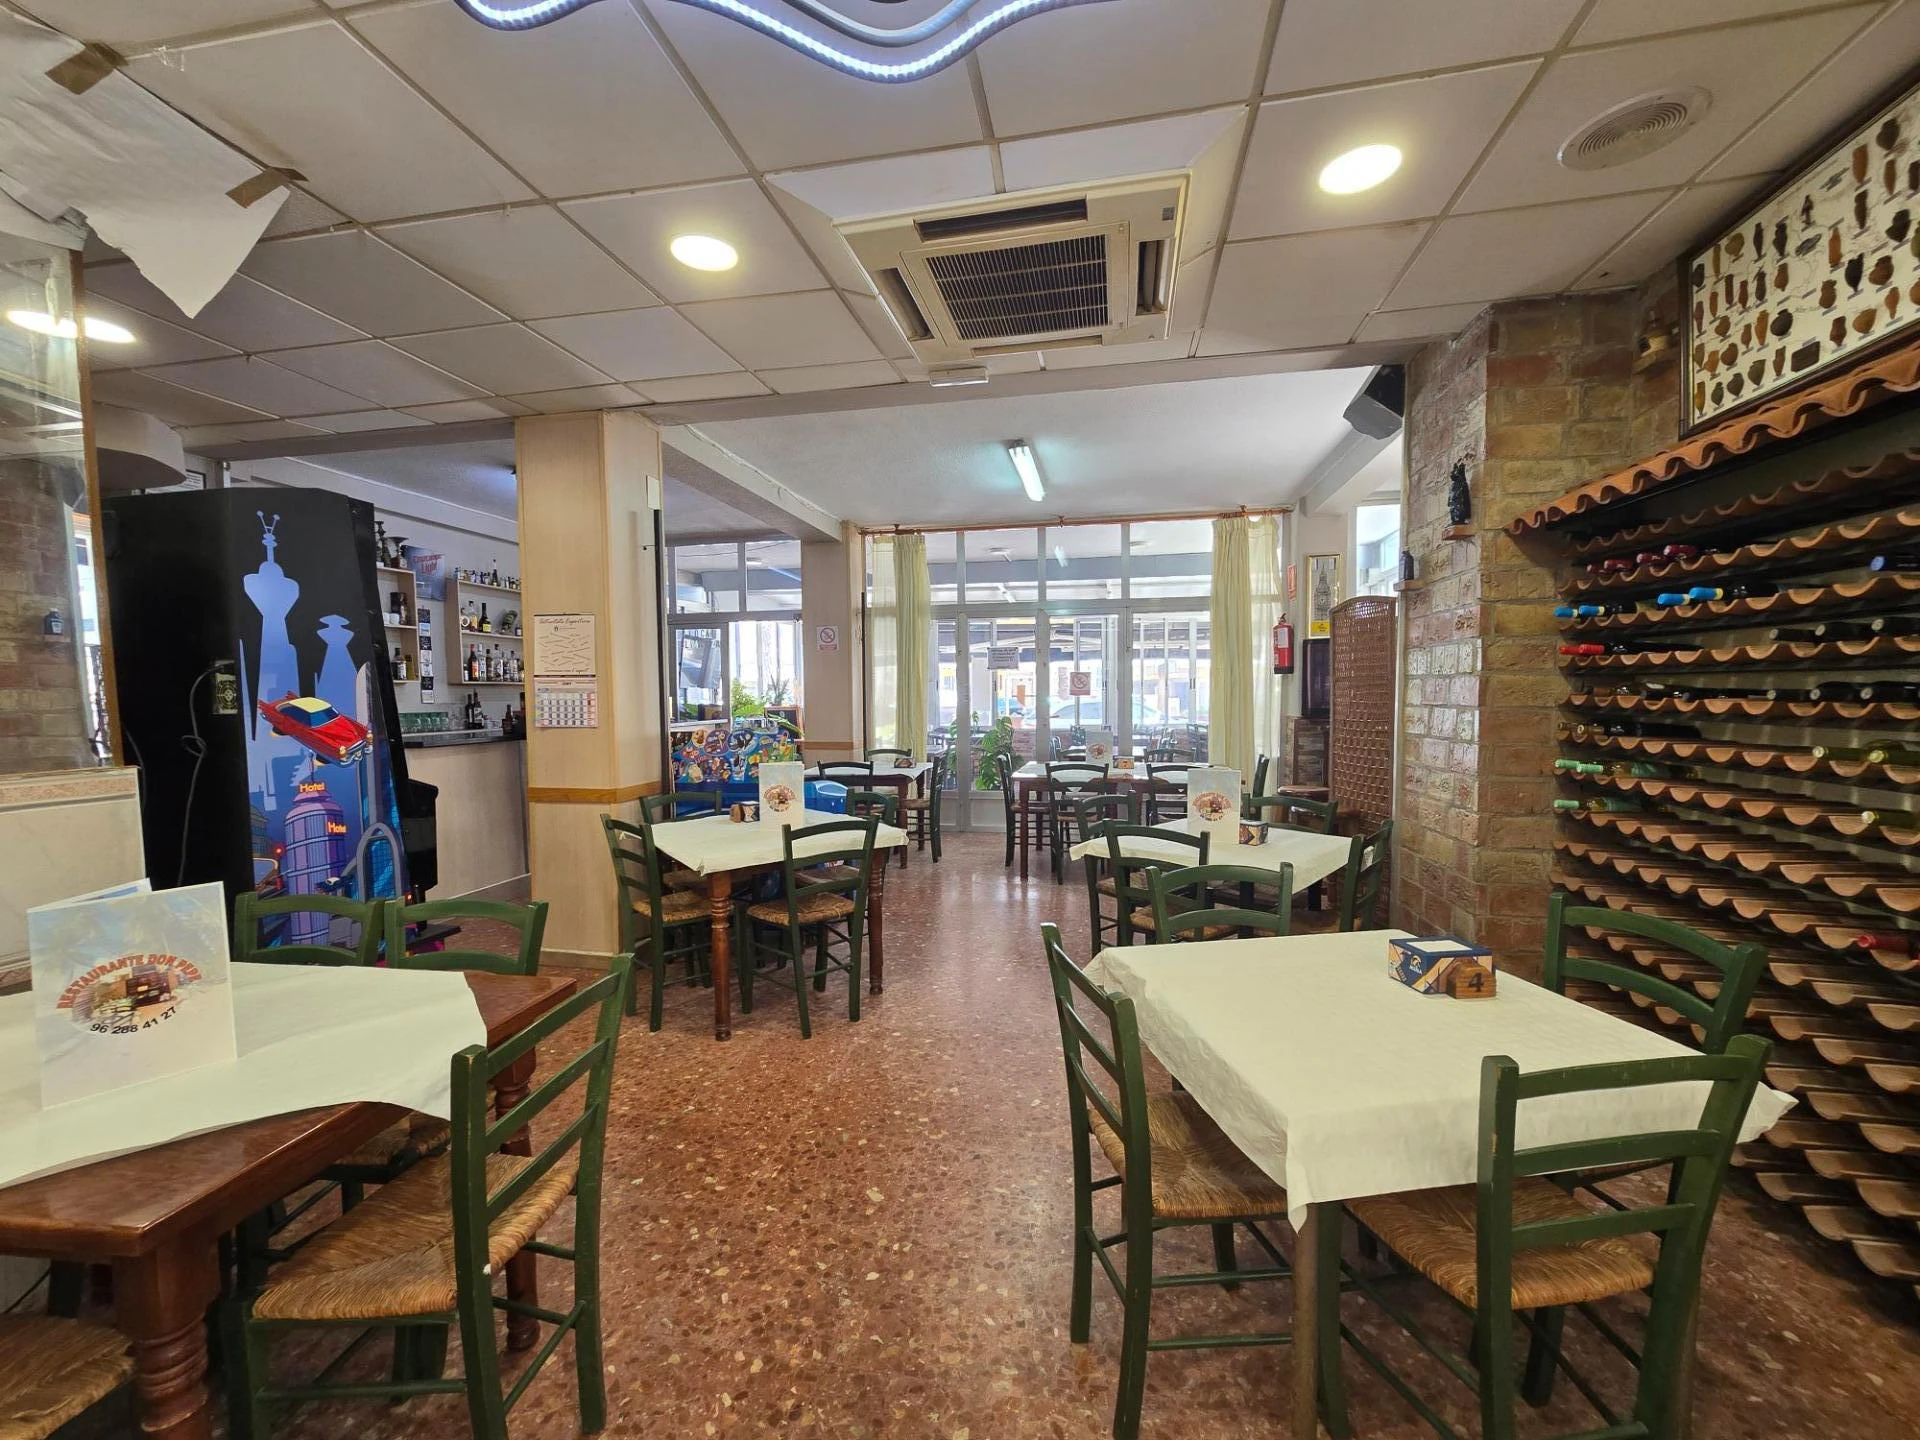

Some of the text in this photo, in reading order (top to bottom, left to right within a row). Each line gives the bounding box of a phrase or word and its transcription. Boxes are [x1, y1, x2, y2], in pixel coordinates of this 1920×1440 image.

[299, 782, 326, 793] Hotel
[327, 821, 347, 833] Hotel
[56, 954, 144, 1009] RESTAURANTE
[147, 953, 178, 966] DON
[1467, 972, 1485, 993] 4
[90, 1006, 177, 1035] 96 288 41 27
